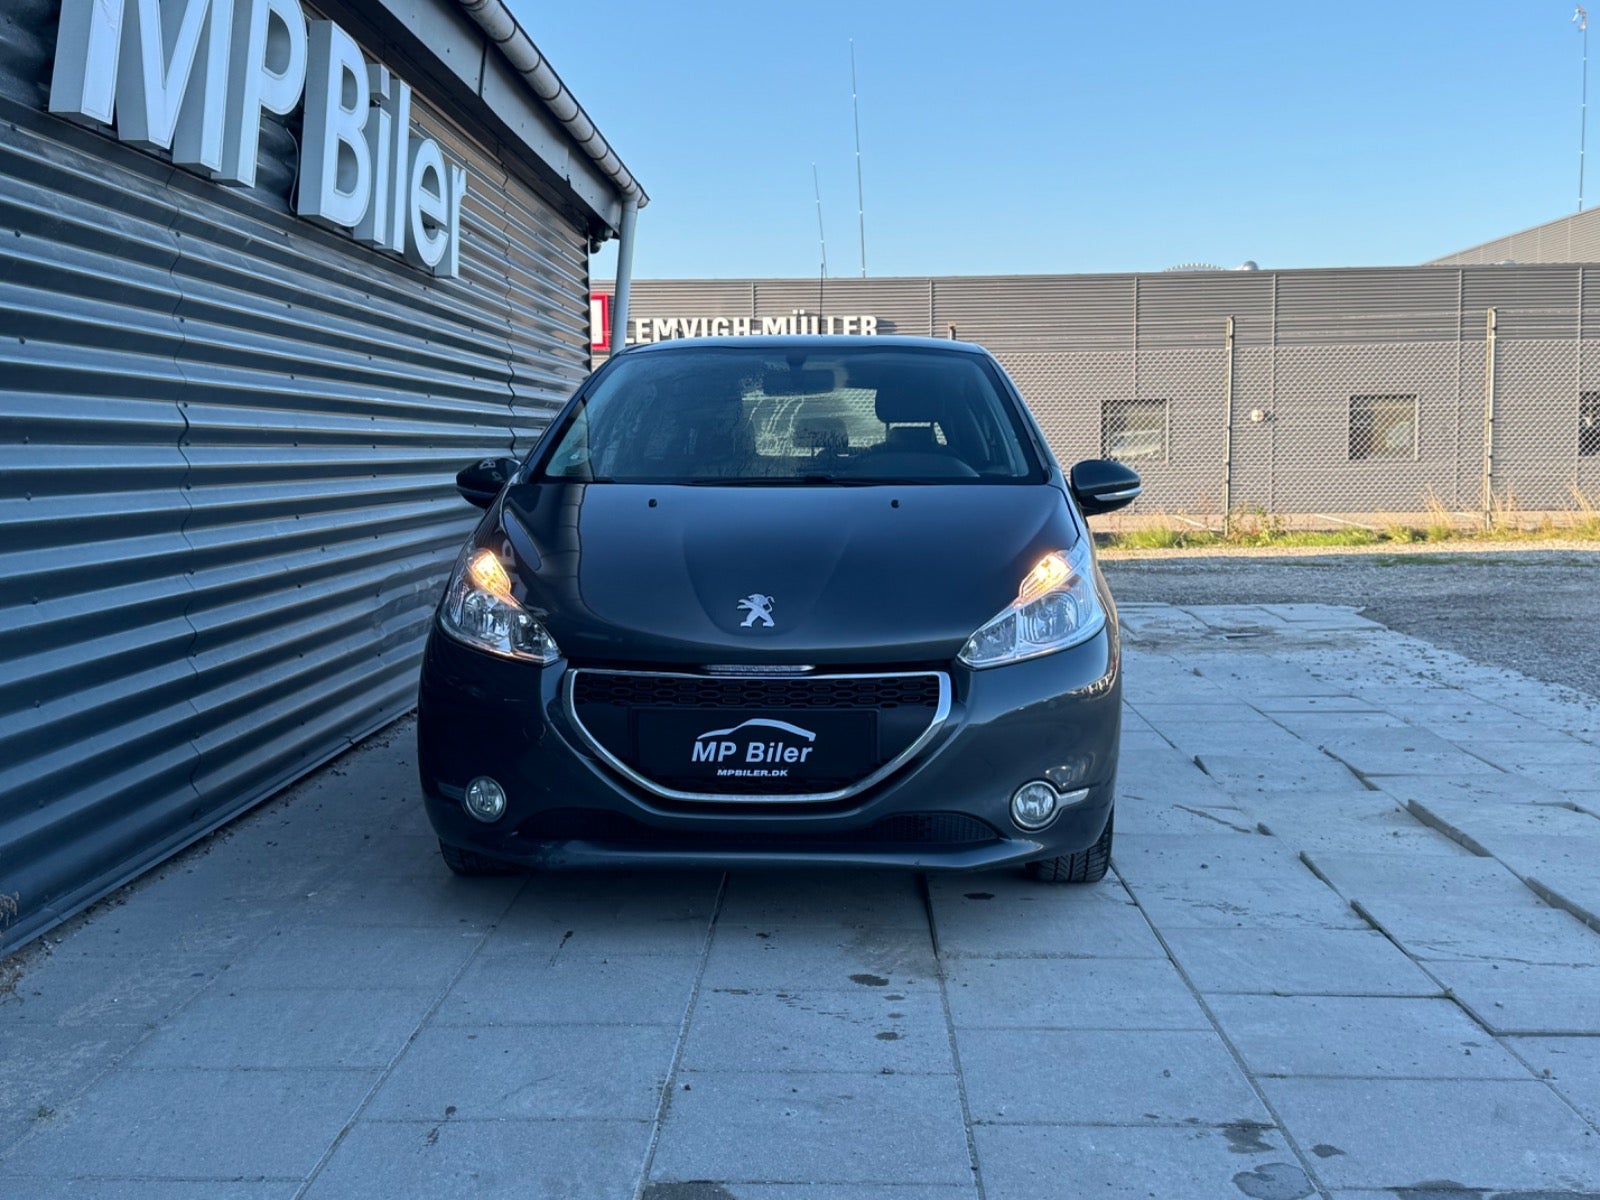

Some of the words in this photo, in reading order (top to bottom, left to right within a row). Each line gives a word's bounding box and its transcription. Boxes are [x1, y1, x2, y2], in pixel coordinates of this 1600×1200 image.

[49, 0, 308, 188] MP
[298, 20, 467, 279] Biler
[691, 741, 736, 762] MP
[745, 741, 813, 763] Biler
[717, 769, 788, 777] MPBILER.DK
